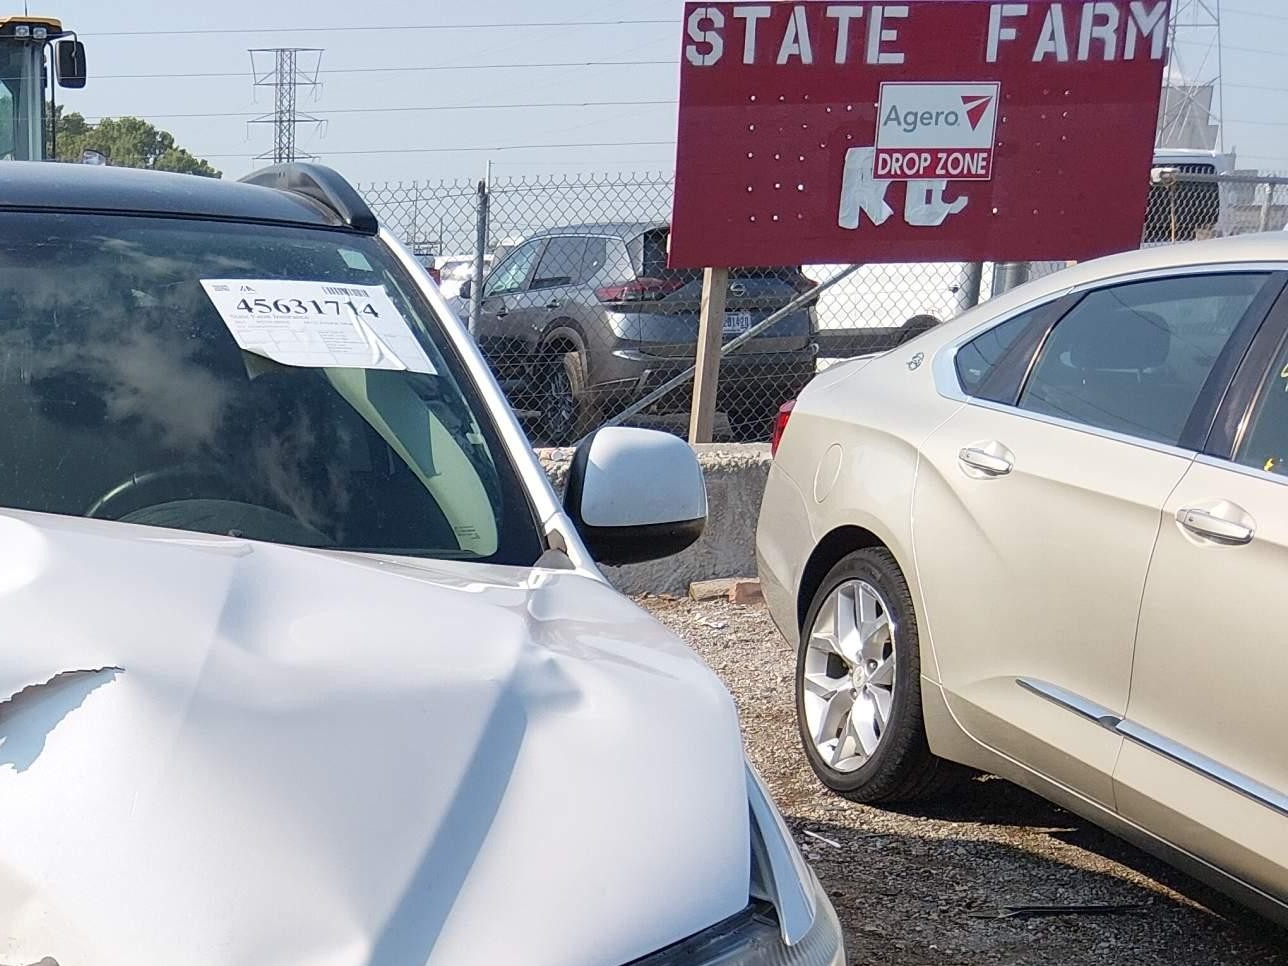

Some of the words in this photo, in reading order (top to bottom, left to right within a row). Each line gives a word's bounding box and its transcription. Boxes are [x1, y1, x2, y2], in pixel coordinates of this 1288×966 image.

[686, 6, 909, 66] STATE
[986, 1, 1168, 63] FARM
[883, 105, 960, 133] Agero
[877, 153, 931, 175] DROP
[935, 153, 988, 175] ZONE
[236, 297, 381, 318] 45631714
